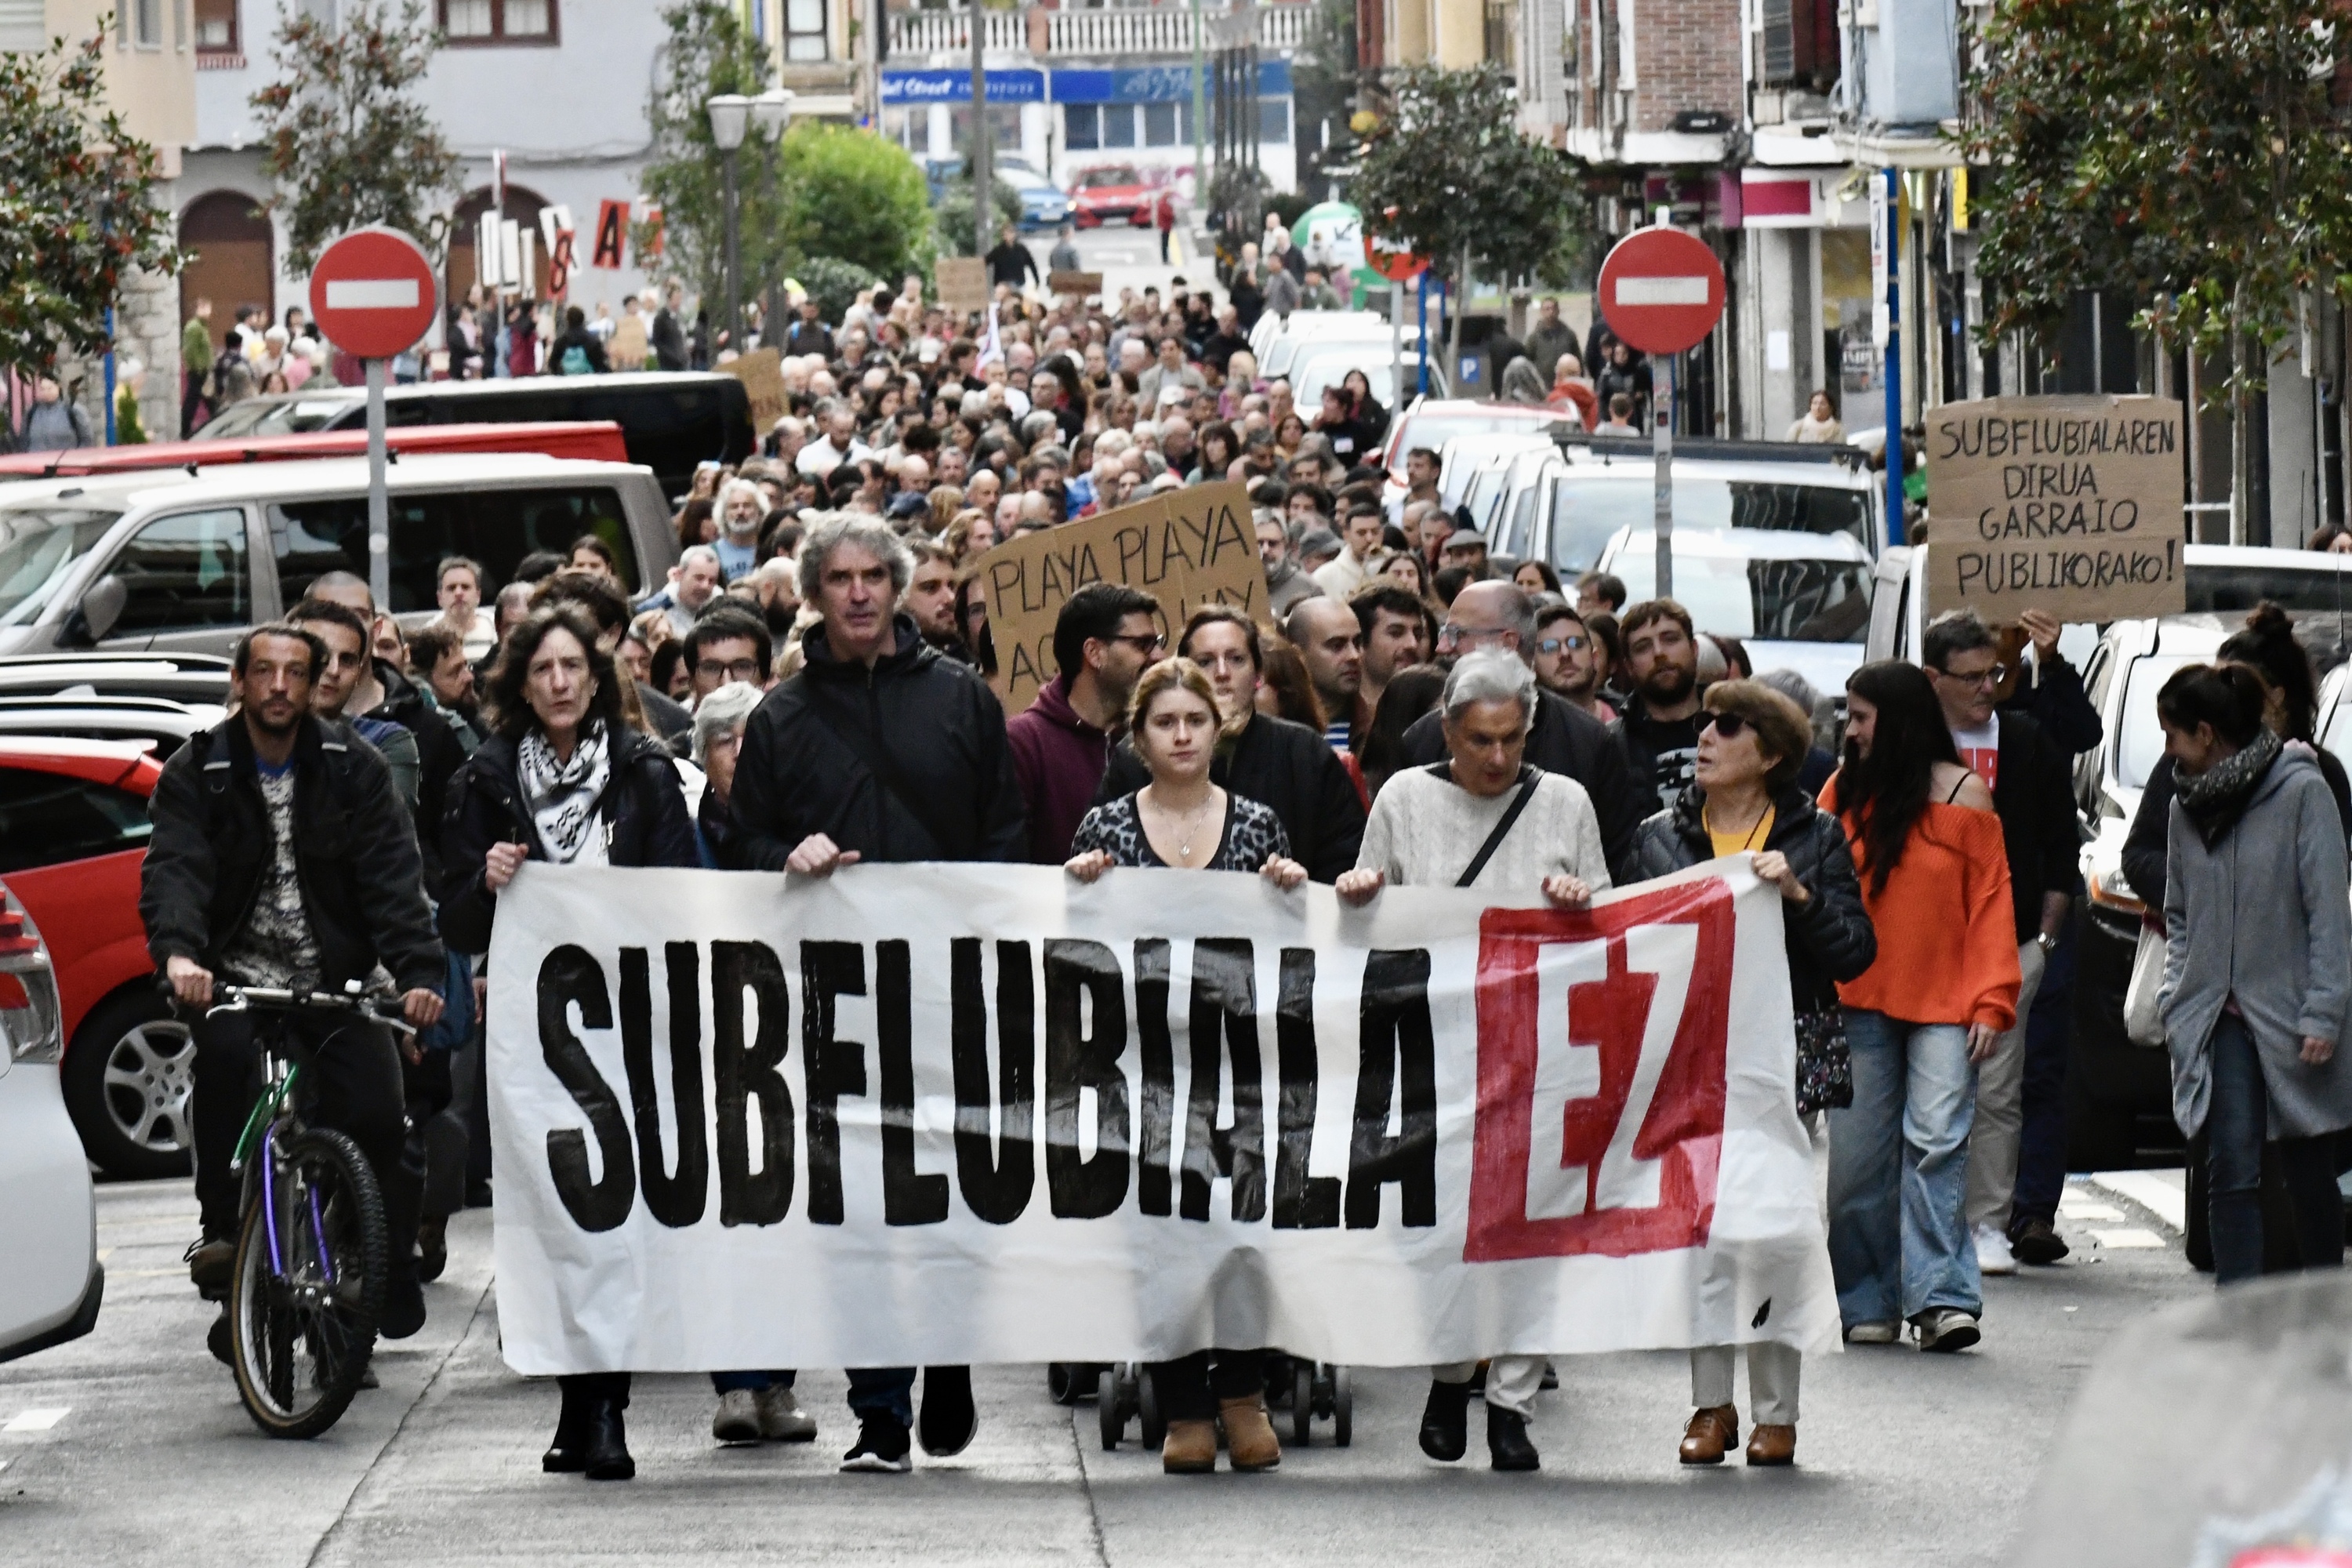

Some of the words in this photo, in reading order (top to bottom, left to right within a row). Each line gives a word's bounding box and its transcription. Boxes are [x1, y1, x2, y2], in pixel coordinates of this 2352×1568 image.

[1461, 358, 1477, 380] P
[1940, 417, 2176, 459] SUBFLUBIALAREN
[2002, 462, 2098, 500] DIRUA
[1979, 499, 2139, 541] GARRAIO
[988, 543, 1103, 619] PLAYA
[1112, 503, 1250, 586] PLAYA
[1956, 539, 2176, 597] PUBLIKORAKO!
[537, 936, 1437, 1232] SUBFLUBIALA
[1526, 923, 1700, 1222] EZ
